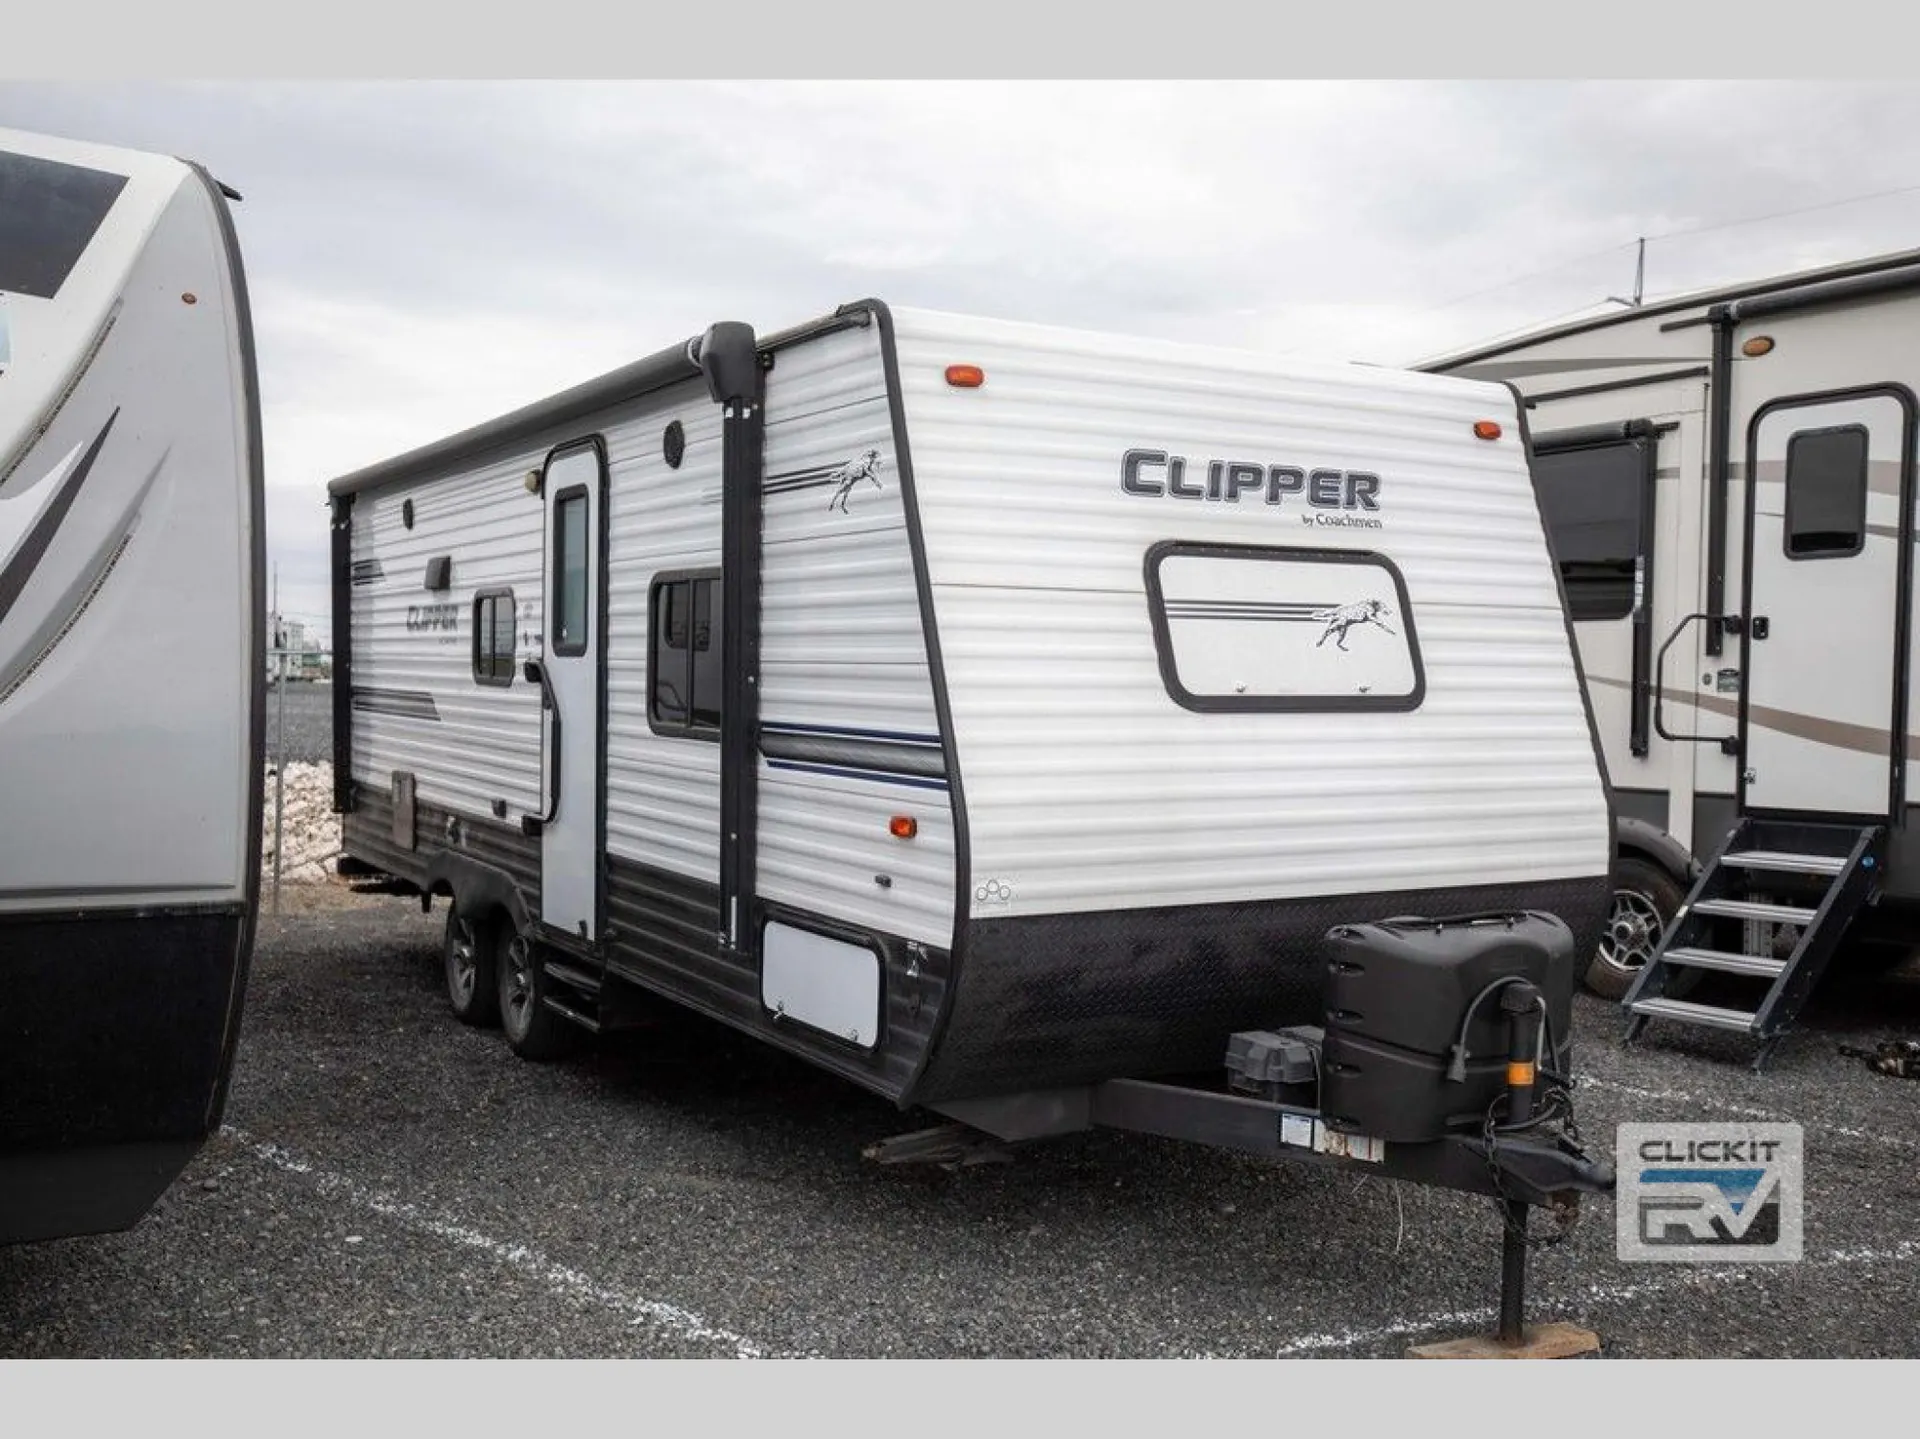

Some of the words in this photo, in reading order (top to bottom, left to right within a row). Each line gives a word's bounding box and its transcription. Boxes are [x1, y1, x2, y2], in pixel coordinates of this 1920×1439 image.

[1121, 448, 1381, 511] CLIPPER
[1301, 515, 1314, 528] by
[1315, 513, 1383, 529] Coachmen
